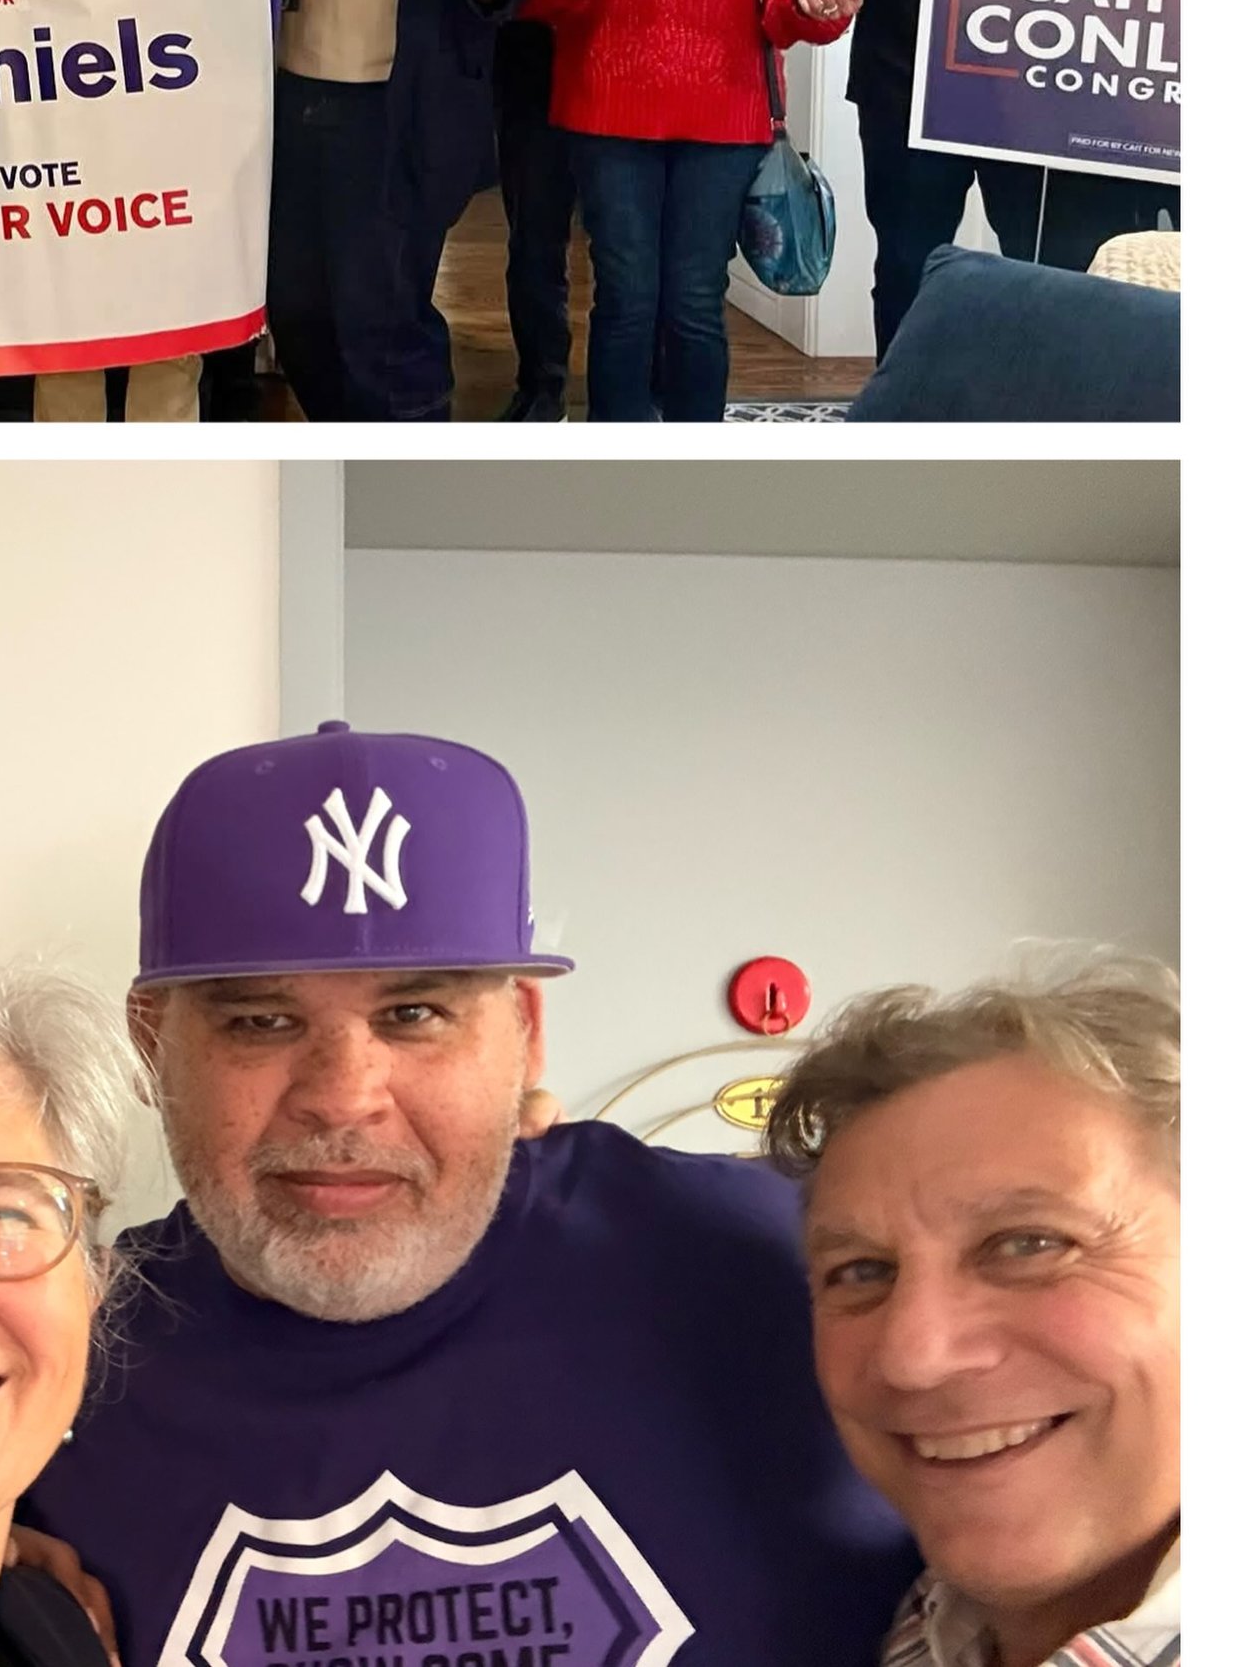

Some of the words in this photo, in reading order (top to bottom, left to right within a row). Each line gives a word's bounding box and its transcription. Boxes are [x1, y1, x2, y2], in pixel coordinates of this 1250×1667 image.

[966, 5, 1178, 72] CONL
[1026, 65, 1180, 104] CONGR
[0, 161, 81, 190] VOTE
[47, 189, 193, 237] VOICE
[300, 787, 411, 914] NY
[257, 1596, 332, 1653] WE
[346, 1576, 573, 1646] PROTECT,
